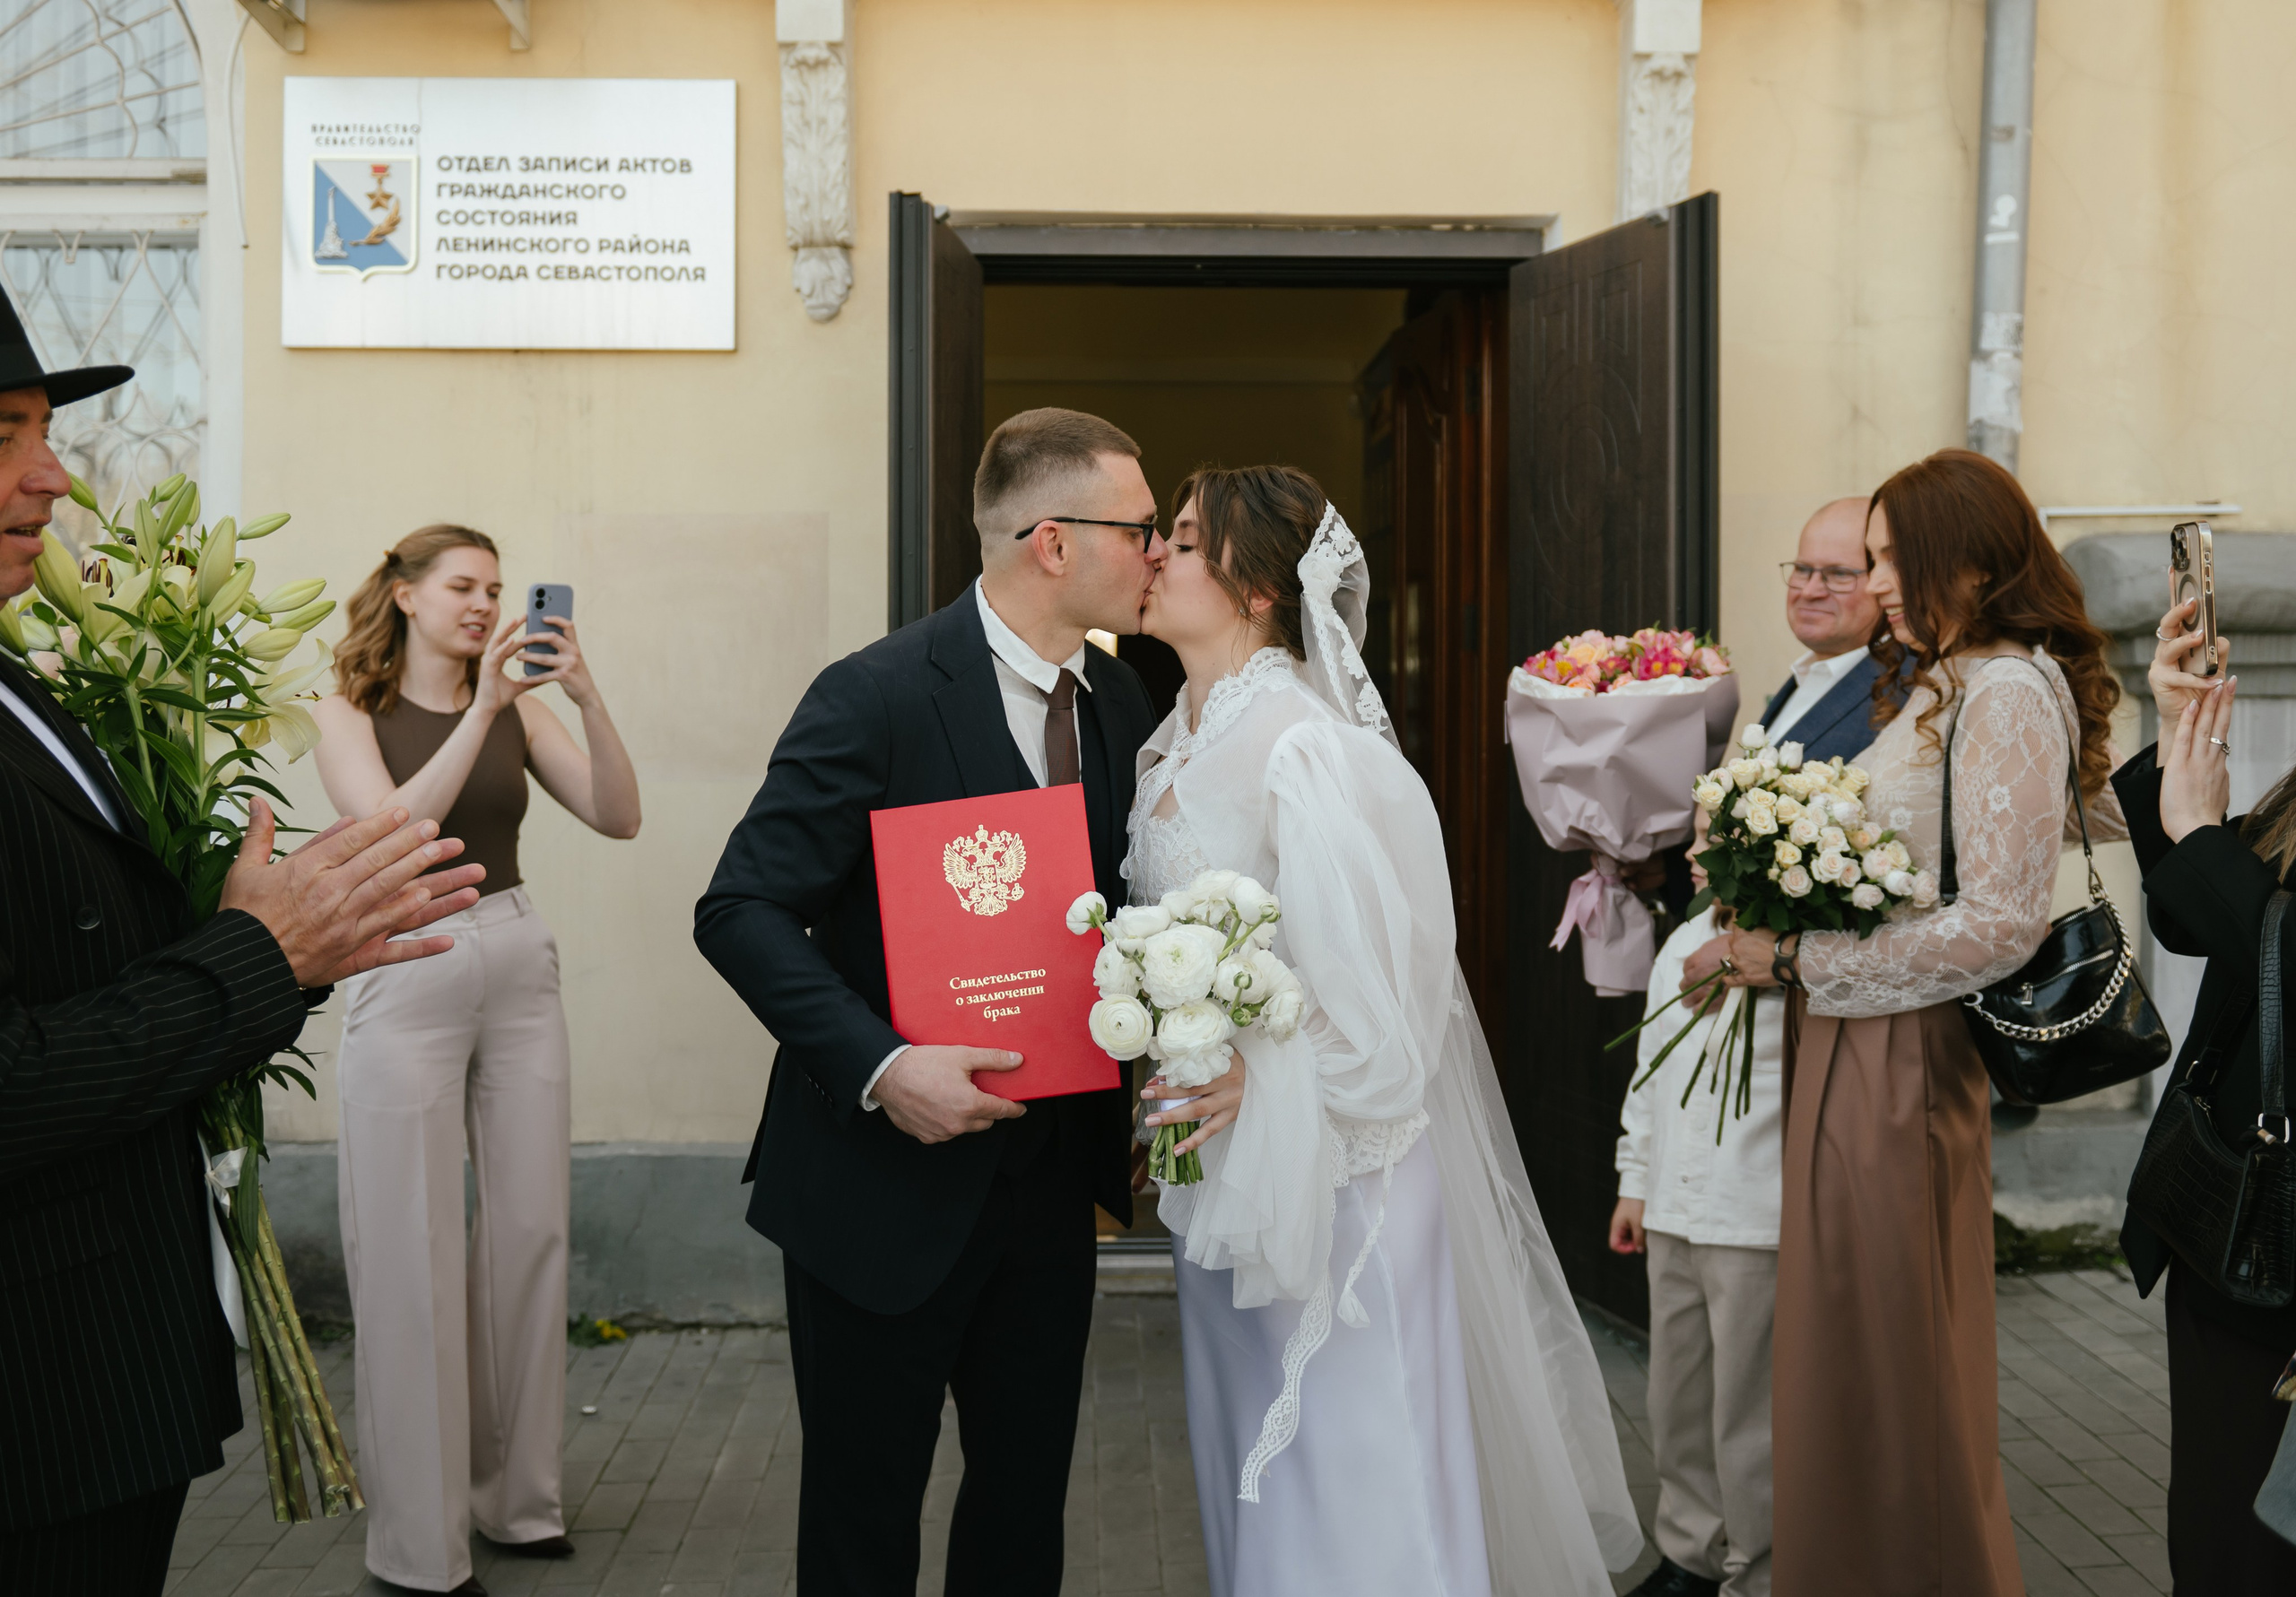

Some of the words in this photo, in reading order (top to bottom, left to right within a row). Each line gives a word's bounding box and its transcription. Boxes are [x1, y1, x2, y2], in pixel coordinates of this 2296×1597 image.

[437, 156, 511, 174] ОТДЕЛ
[519, 156, 610, 174] ЗАПИСИ
[617, 158, 693, 175] АКТОВ
[437, 183, 627, 201] ГРАЖДАНСКОГО
[437, 210, 578, 227] СОСТОЯНИЯ
[437, 237, 591, 255] ЛЕНИНСКОГО
[599, 235, 691, 256] РАЙОНА
[437, 265, 529, 282] ГОРОДА
[537, 265, 707, 282] СЕВАСТОПОЛЯ
[949, 968, 1046, 990] Свидетельство
[955, 997, 964, 1006] о
[966, 985, 1045, 1005] заключении
[983, 1005, 1021, 1022] брака
